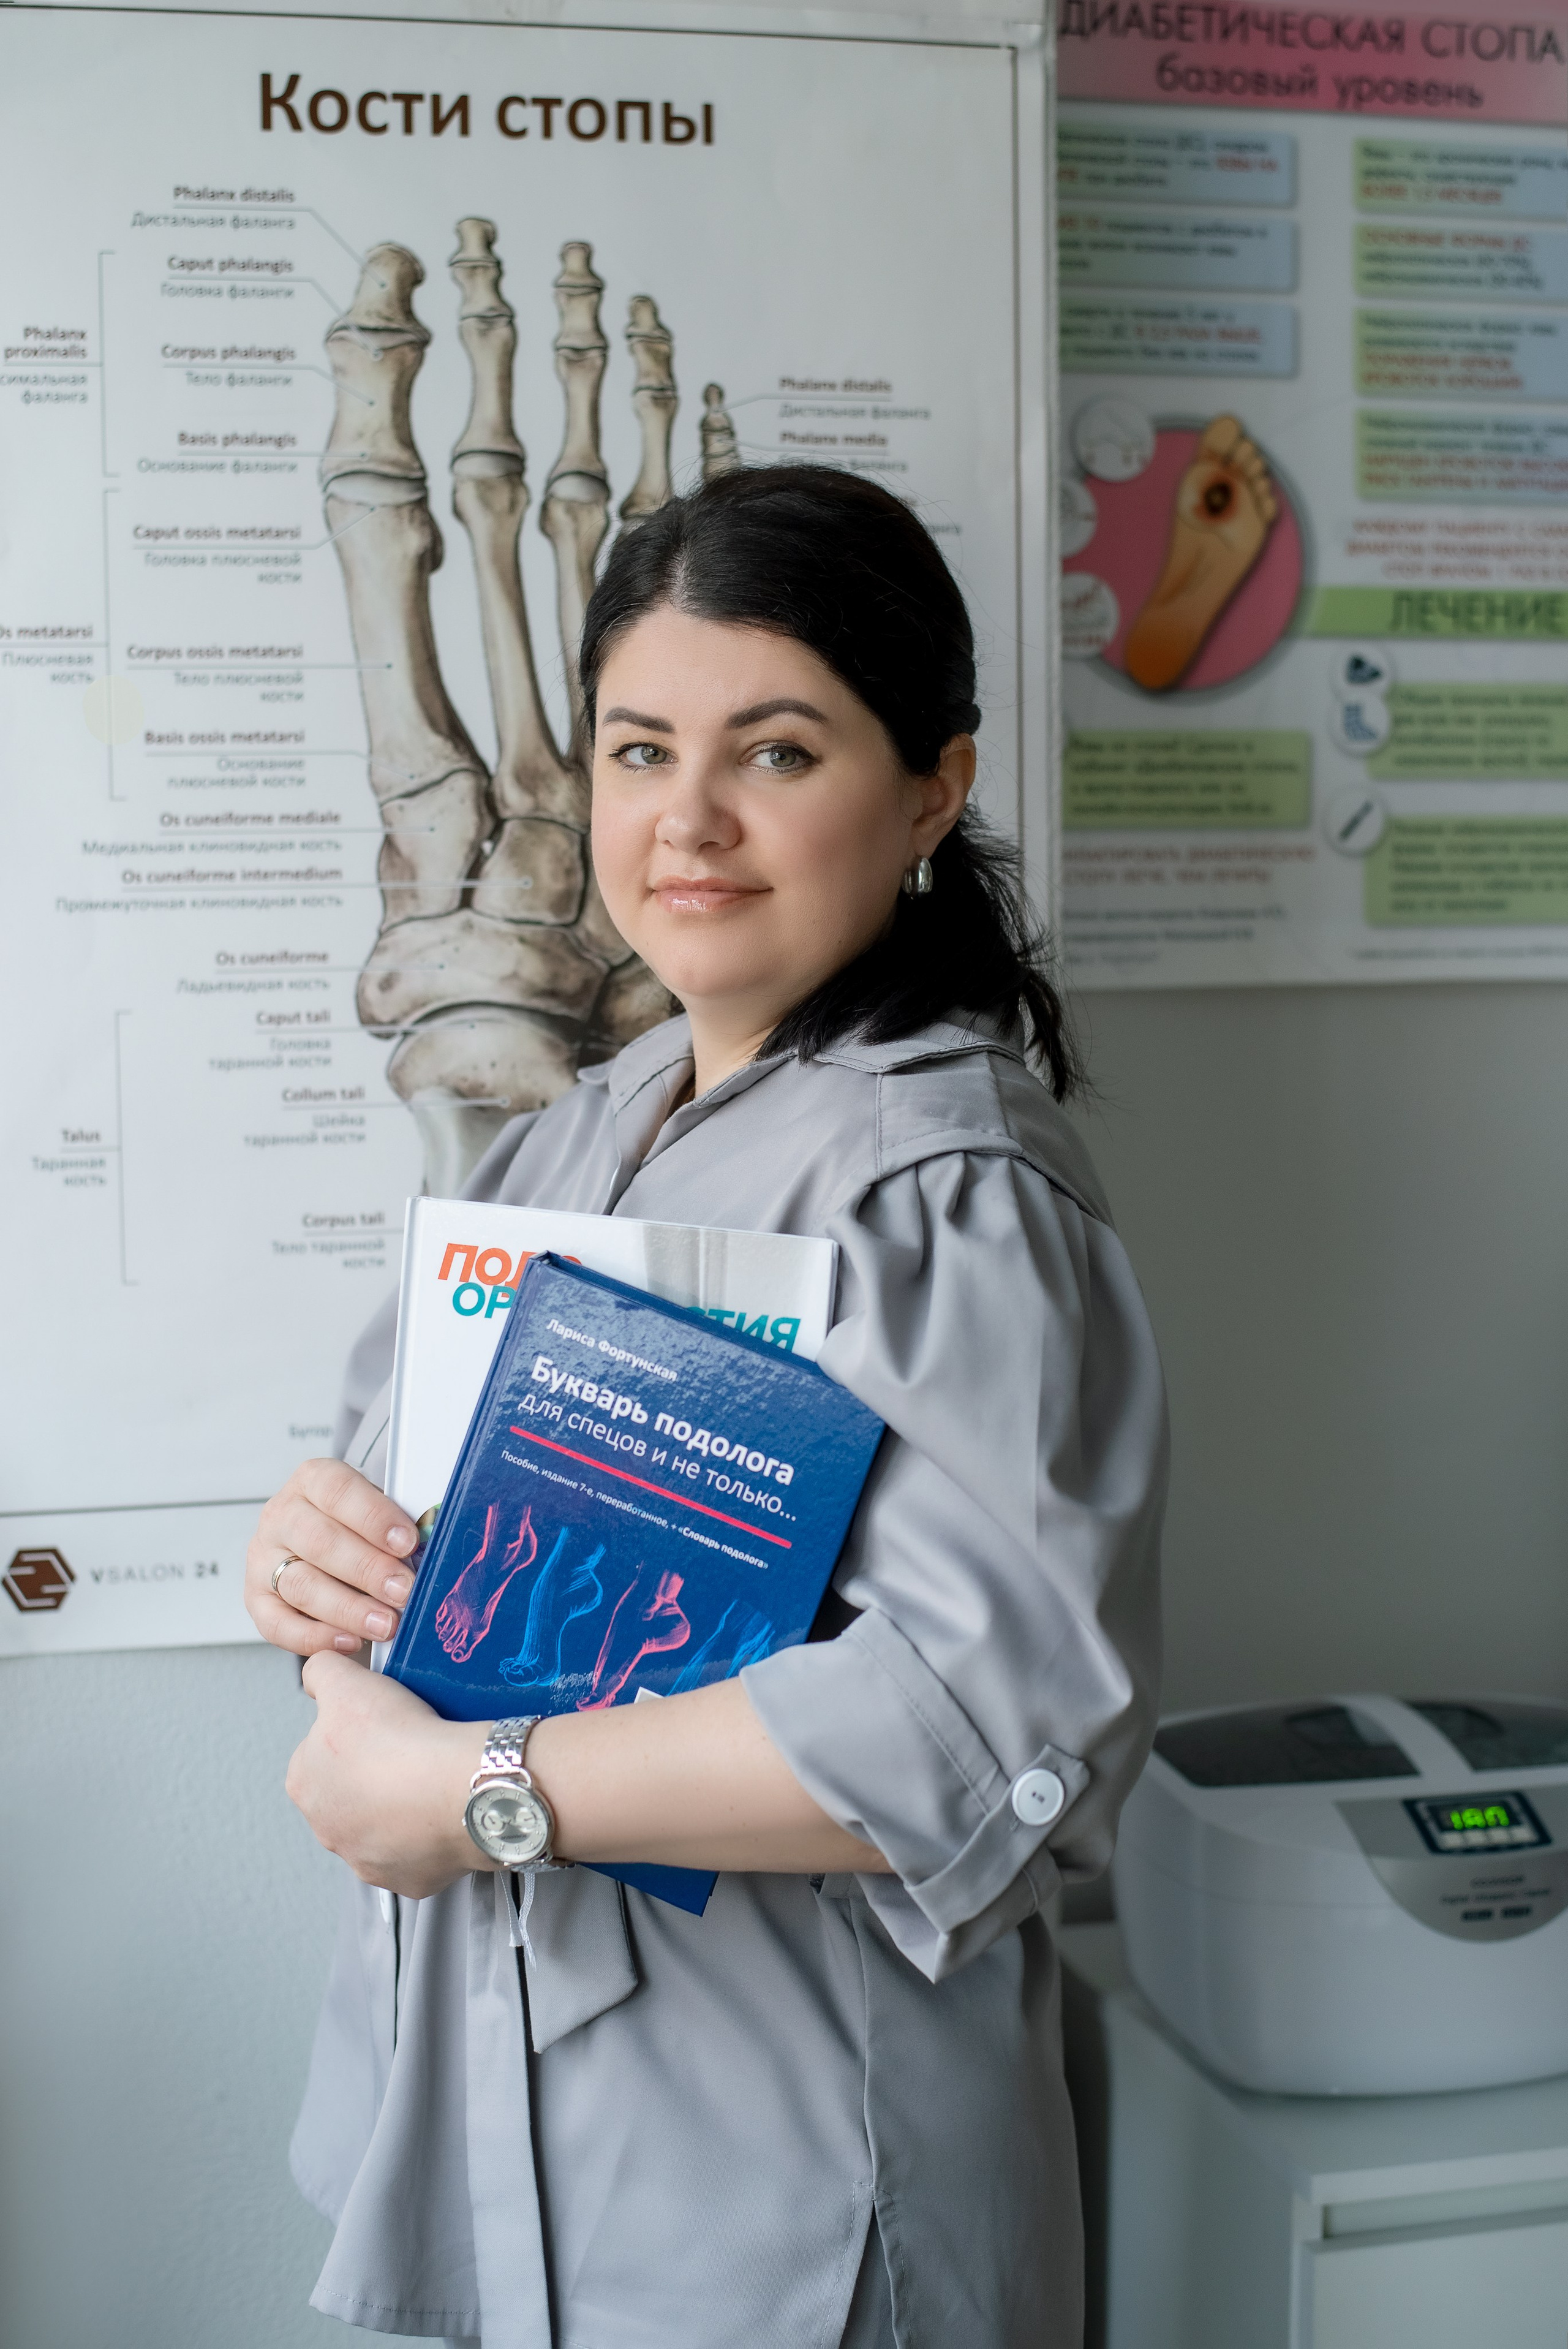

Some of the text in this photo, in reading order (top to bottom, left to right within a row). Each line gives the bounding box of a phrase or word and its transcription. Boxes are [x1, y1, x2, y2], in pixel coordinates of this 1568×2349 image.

[1057, 0, 1564, 64] ДИАБЕТИЧЕСКАЯ СТОПА
[1156, 51, 1485, 111] базовый уровень
[260, 72, 714, 145] Кости стопы
[173, 185, 296, 203] Phalanx distalis
[167, 255, 294, 275] Caput phalangis
[23, 326, 87, 341] Phalanx
[3, 343, 88, 362] proximalis
[160, 343, 296, 364] Corpus phalangis
[177, 431, 298, 450] Basis phalangis
[132, 524, 301, 542] Caput ossis metatarsi
[1390, 591, 1564, 634] ЛЕЧЕНИЕ
[16, 626, 94, 640] metatarsi
[126, 644, 304, 662] Corpus ossis metatarsi
[144, 730, 306, 745] Basis ossis metatarsi
[159, 810, 342, 828] Os cuneiforme mediale
[121, 866, 343, 885] Os cuneiforme intermedium
[214, 949, 330, 967] Os cuneiforme
[255, 1009, 331, 1027] Caput tali
[281, 1086, 366, 1103] Collum tali
[61, 1128, 102, 1144] Talus
[301, 1211, 385, 1230] Corpus tali
[546, 1318, 678, 1382] Лариса Фортунская
[532, 1355, 795, 1485] Букварь подолога
[518, 1393, 796, 1522] для спецов и не только...
[502, 1450, 539, 1475] Пособие,
[541, 1468, 578, 1490] издание
[579, 1482, 595, 1499] 7-е,
[595, 1491, 669, 1530] переработанное,
[678, 1526, 721, 1551] «Словарь
[721, 1543, 768, 1570] подолога»
[89, 1562, 219, 1584] VSALON 24
